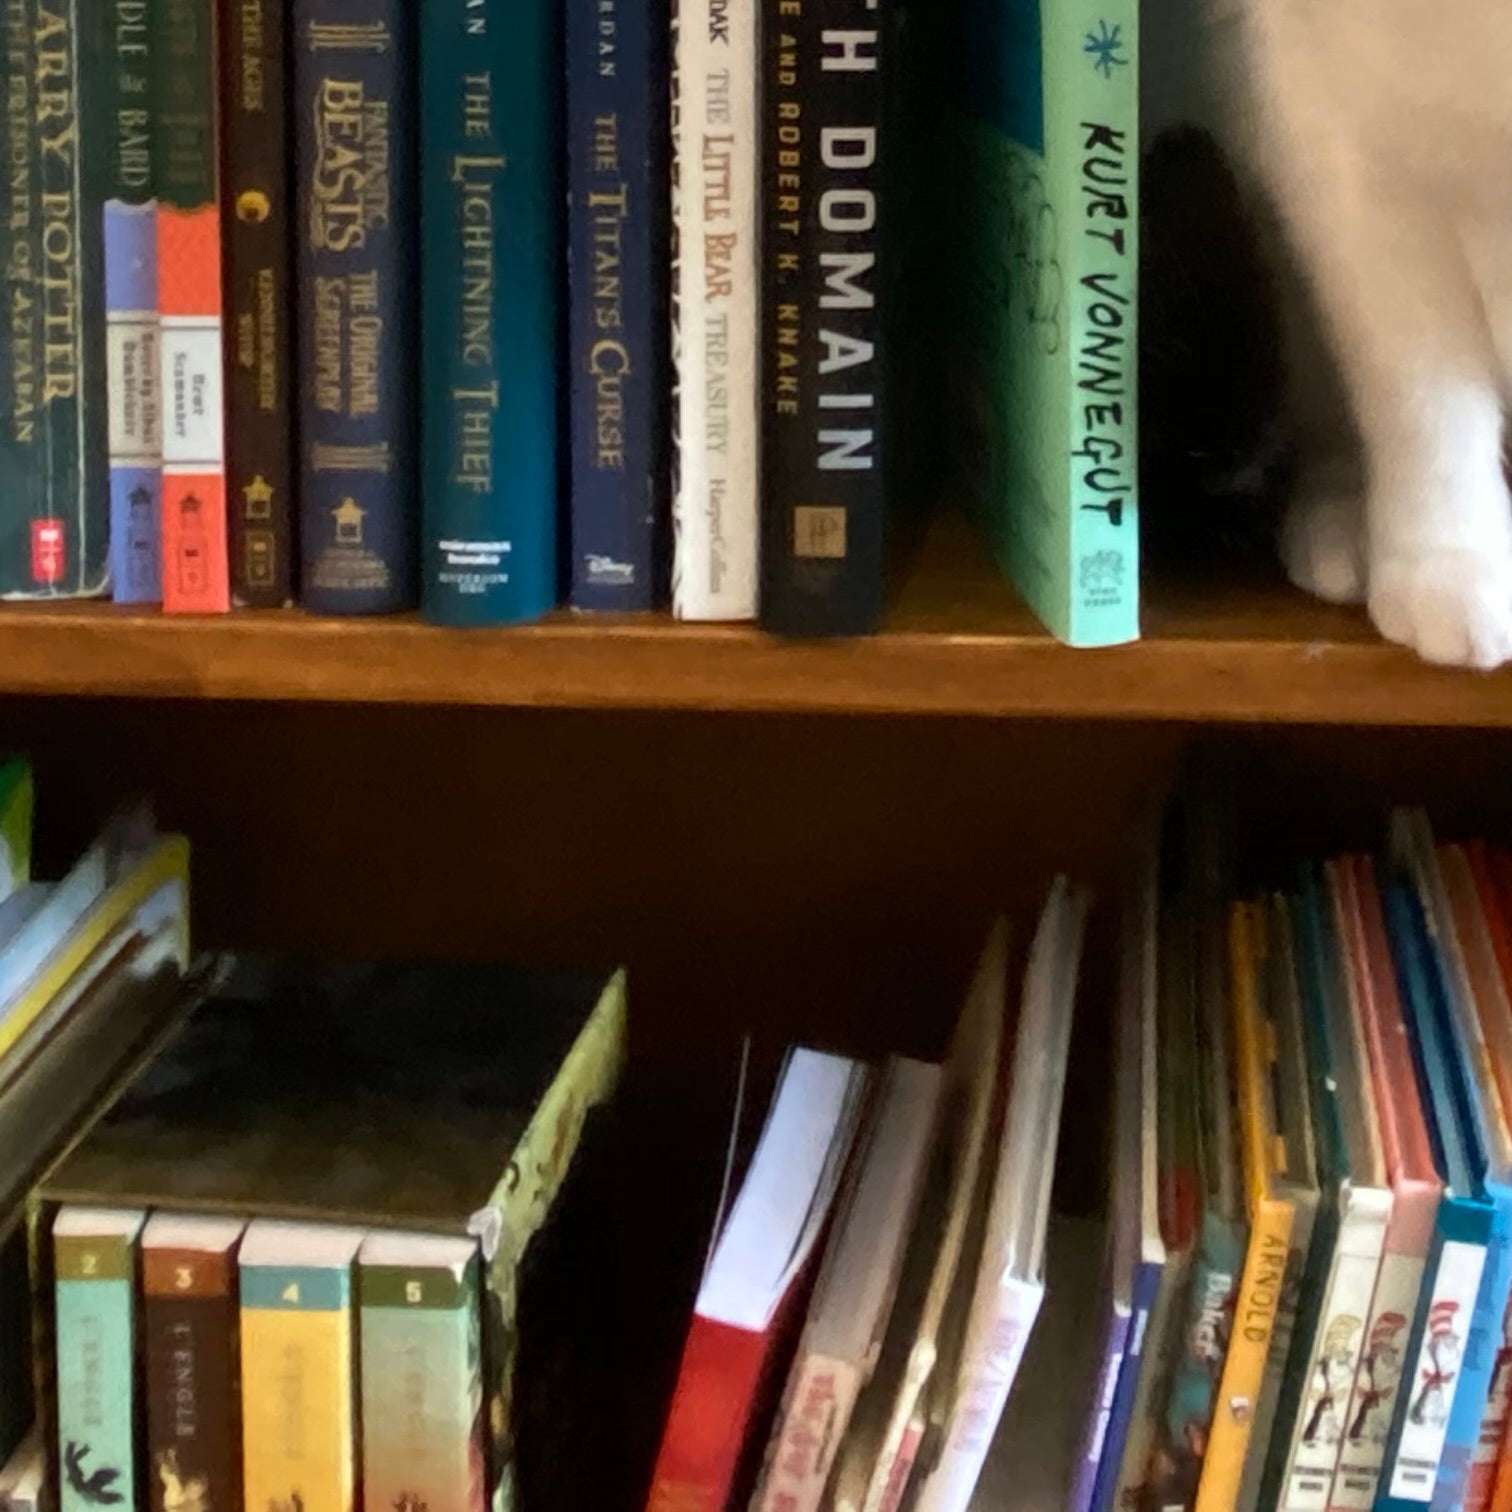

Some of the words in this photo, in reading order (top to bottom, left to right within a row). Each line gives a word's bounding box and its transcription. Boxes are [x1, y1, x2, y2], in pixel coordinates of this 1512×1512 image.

[465, 70, 493, 138] THE
[702, 68, 729, 126] THE
[777, 34, 802, 88] AND
[118, 109, 151, 187] BARD
[318, 77, 367, 252] BEASTS
[362, 100, 390, 229] FANTASTIC
[594, 112, 619, 172] THE
[701, 131, 735, 224] LITTLE
[776, 100, 801, 238] ROBERT
[1080, 120, 1126, 258] KURT
[40, 192, 78, 404] POTTER
[452, 154, 506, 368] LIGHTNING
[587, 182, 631, 330] TITAN'S
[703, 229, 738, 304] BEAR
[816, 126, 877, 472] DOMAIN
[12, 289, 35, 444] AZKABAN
[588, 340, 631, 472] CURSE
[703, 312, 730, 457] TREASURY
[776, 301, 800, 416] KNAKE
[1070, 270, 1132, 529] VONNEGUT
[453, 379, 502, 495] THIEF
[81, 1253, 97, 1275] 2
[175, 1268, 193, 1288] 3
[281, 1283, 300, 1304] 4
[405, 1281, 423, 1304] 5
[1243, 1233, 1286, 1343] ARNOLD
